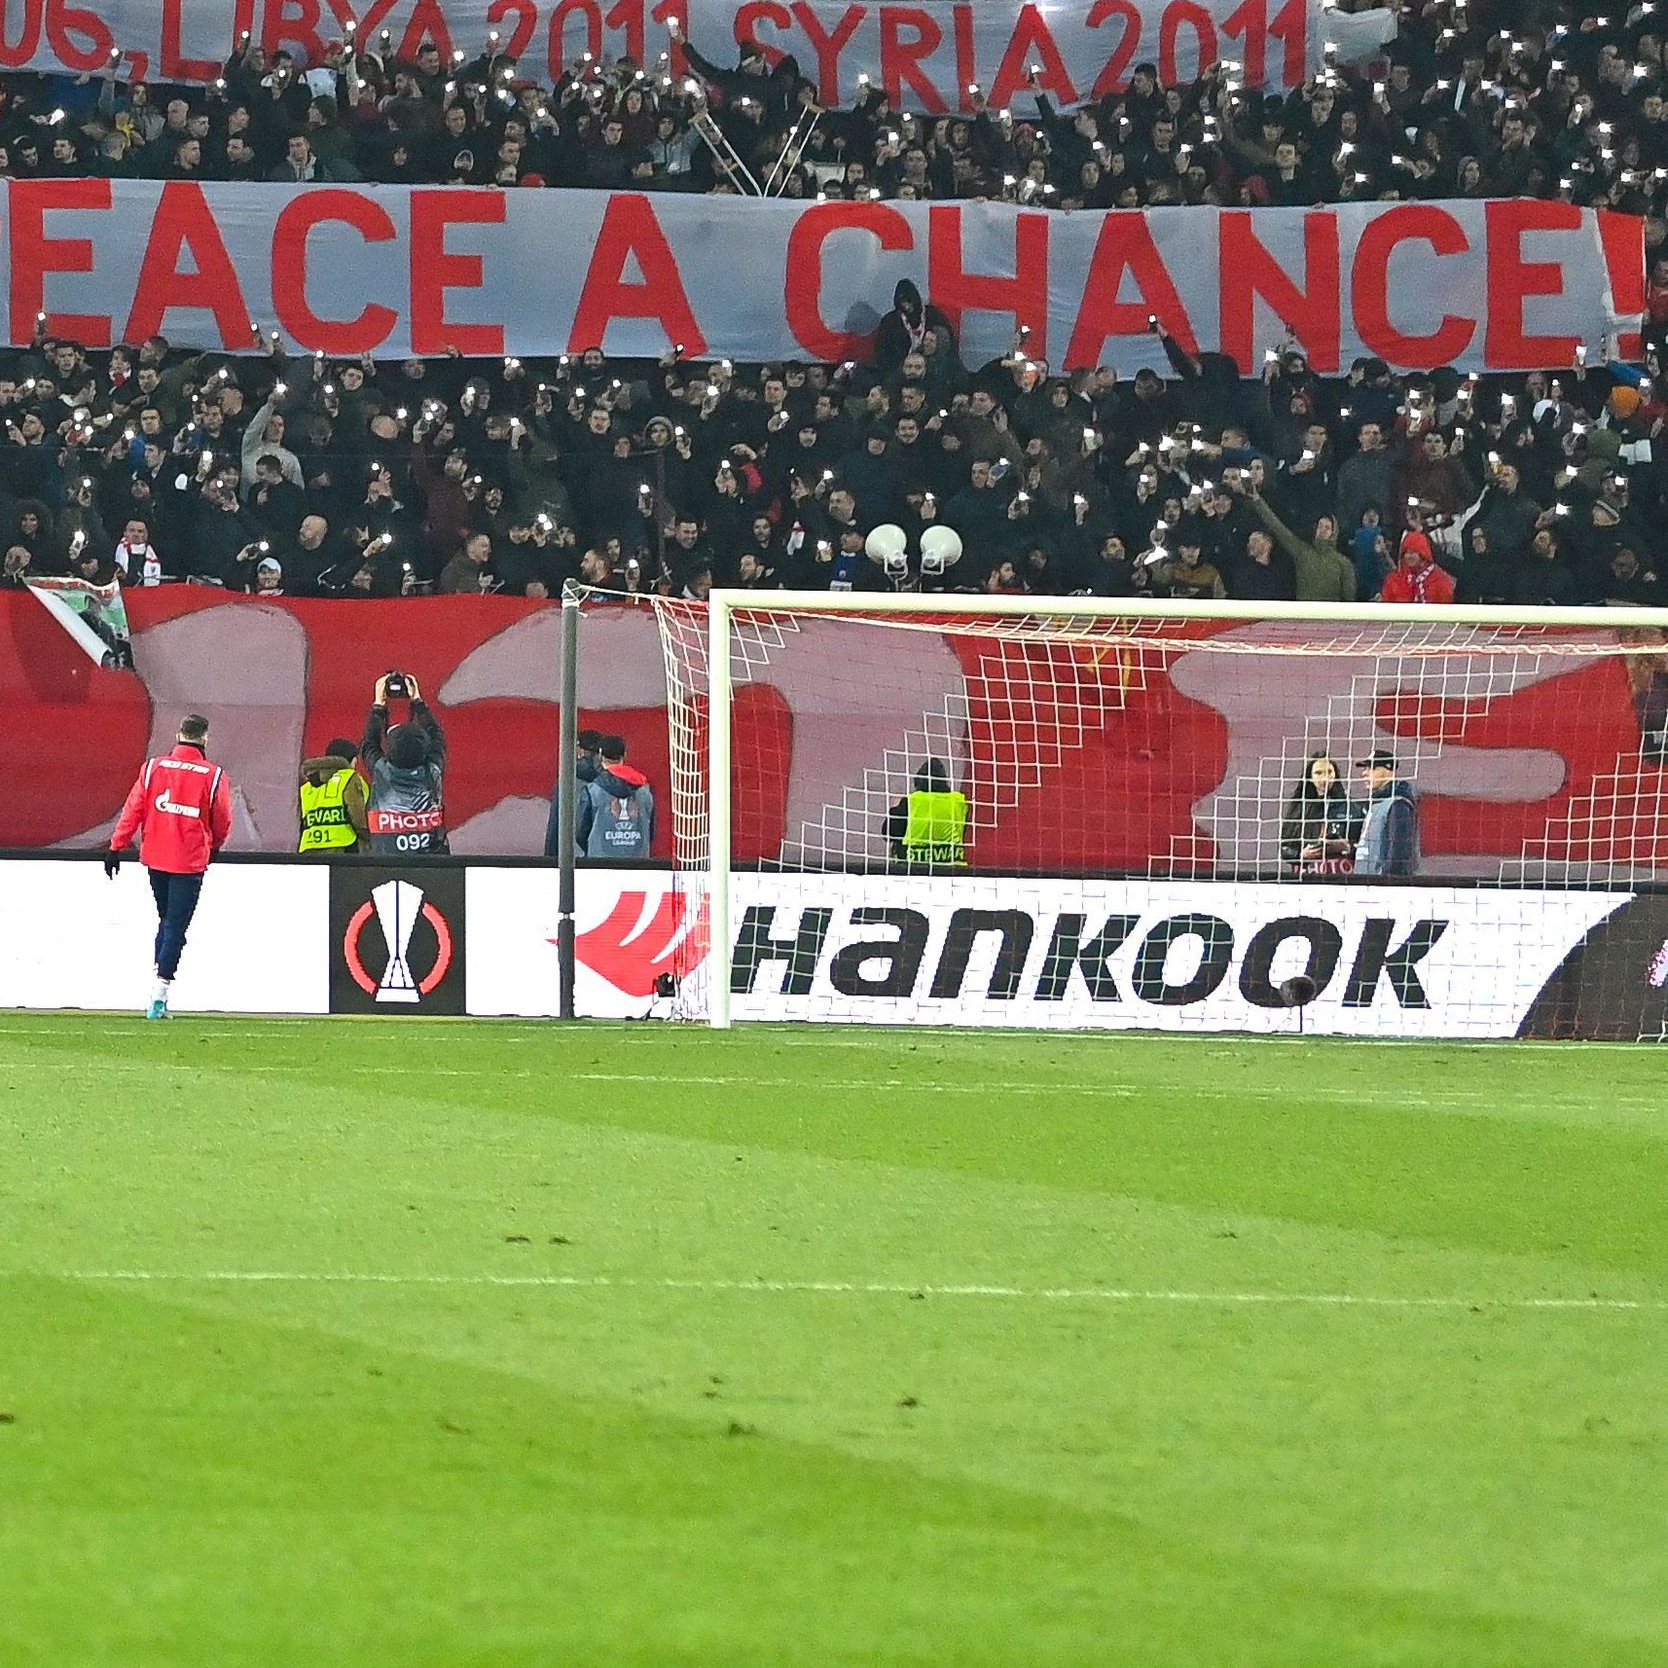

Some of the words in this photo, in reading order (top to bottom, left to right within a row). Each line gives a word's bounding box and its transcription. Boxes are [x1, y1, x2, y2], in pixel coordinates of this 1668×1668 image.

[566, 193, 710, 360] A
[785, 198, 1646, 376] CHANCE!
[396, 833, 430, 852] 092
[604, 830, 642, 840] EUROPA
